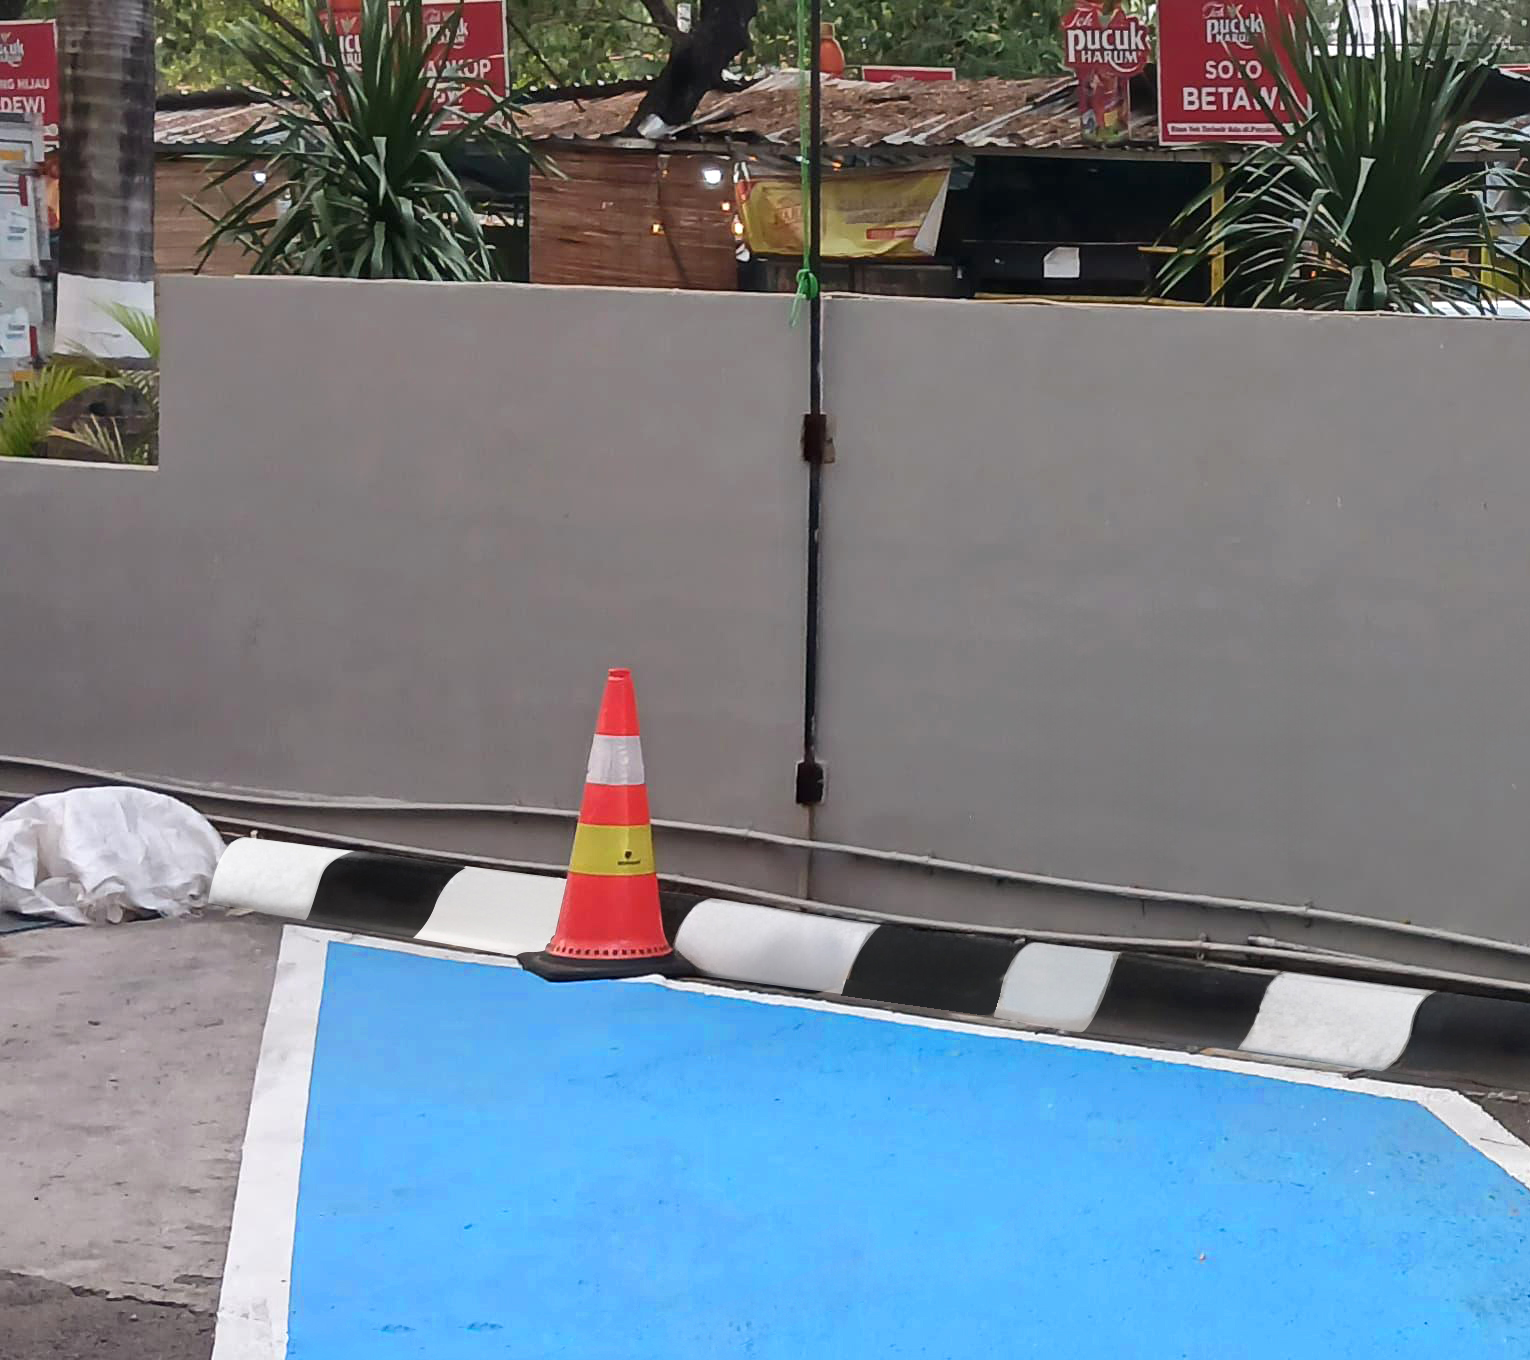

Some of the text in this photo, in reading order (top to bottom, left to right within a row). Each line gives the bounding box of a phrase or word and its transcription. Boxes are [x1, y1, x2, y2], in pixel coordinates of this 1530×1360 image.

[1064, 8, 1093, 28] Teh
[1067, 22, 1145, 63] pucuk
[1082, 51, 1139, 68] HARUM
[1205, 60, 1263, 79] SOTO
[0, 96, 45, 113] DEWI
